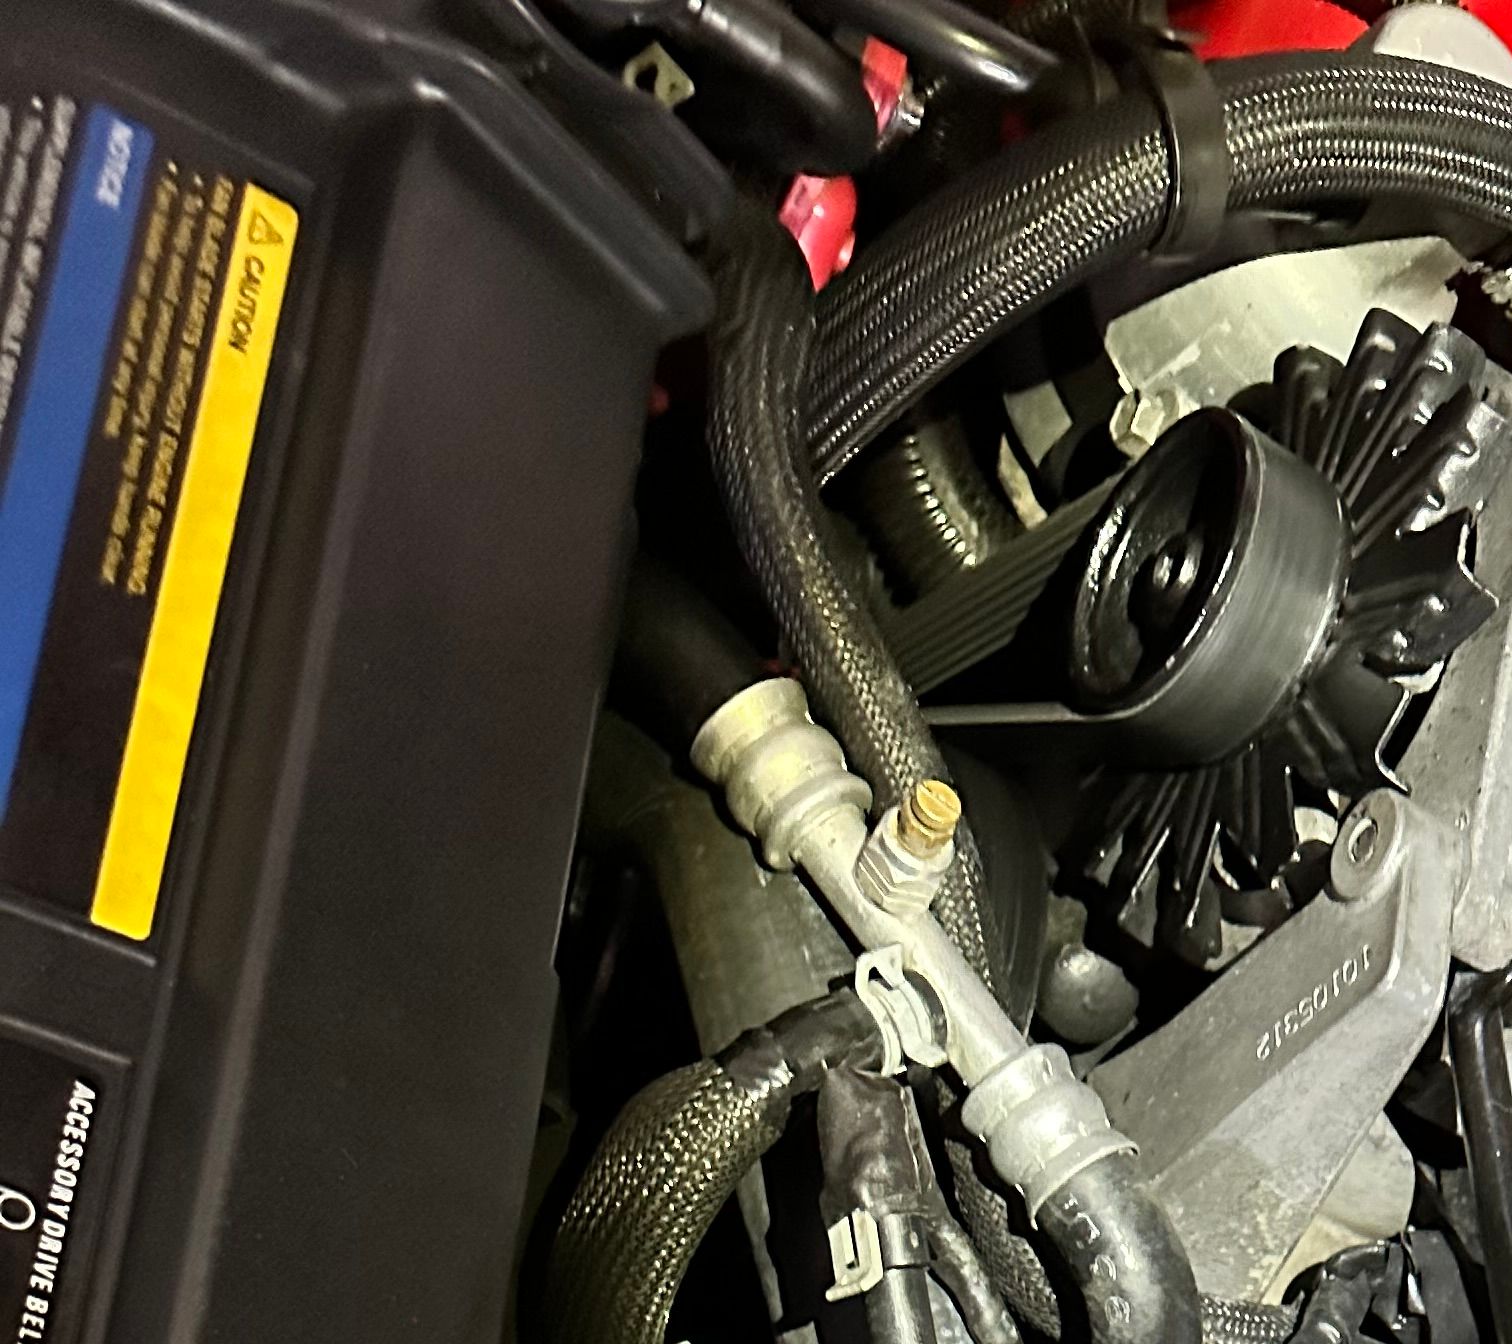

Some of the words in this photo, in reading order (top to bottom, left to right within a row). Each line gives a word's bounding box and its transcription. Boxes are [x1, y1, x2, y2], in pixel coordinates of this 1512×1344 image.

[94, 118, 133, 210] NOTICE
[225, 253, 266, 355] CAUTION
[1260, 943, 1367, 1062] 10105312
[45, 1079, 96, 1221] ACCESSORY
[28, 1217, 66, 1294] DRIVE
